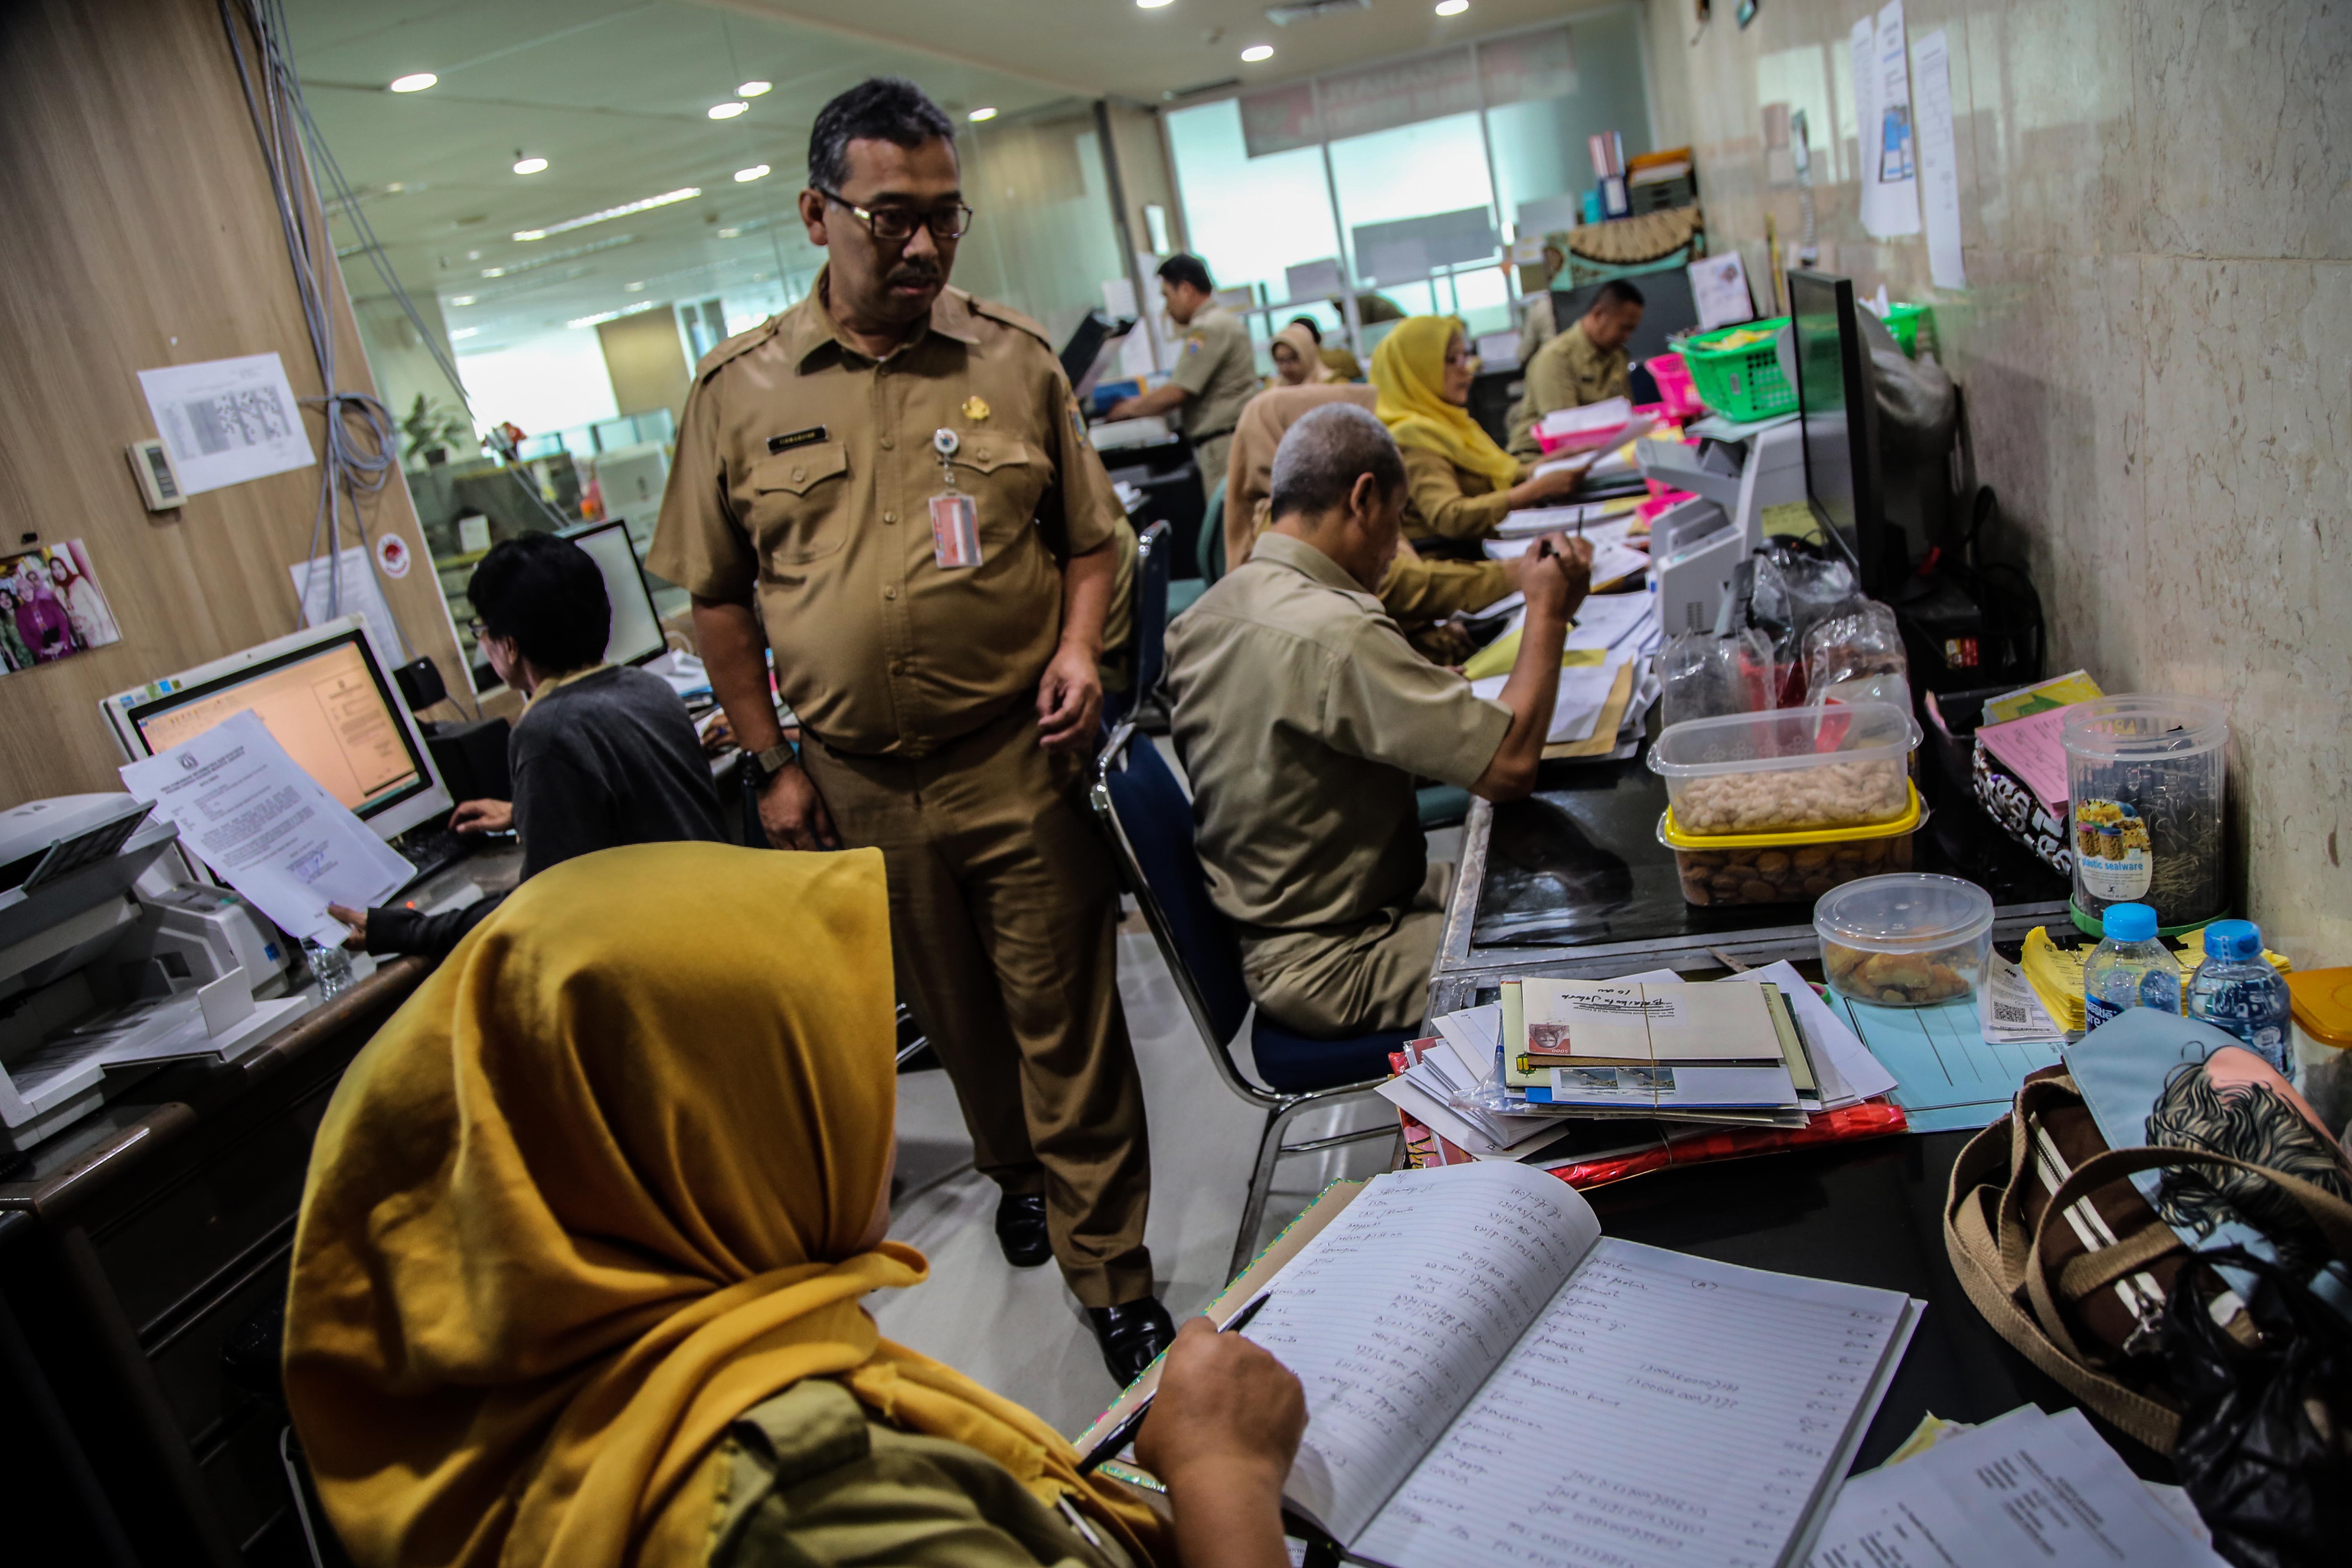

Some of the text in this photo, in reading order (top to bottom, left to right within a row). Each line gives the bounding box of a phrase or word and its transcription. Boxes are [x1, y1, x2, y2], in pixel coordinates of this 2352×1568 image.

[2082, 858, 2143, 871] plastic sealware
[2086, 1012, 2101, 1027] ure
